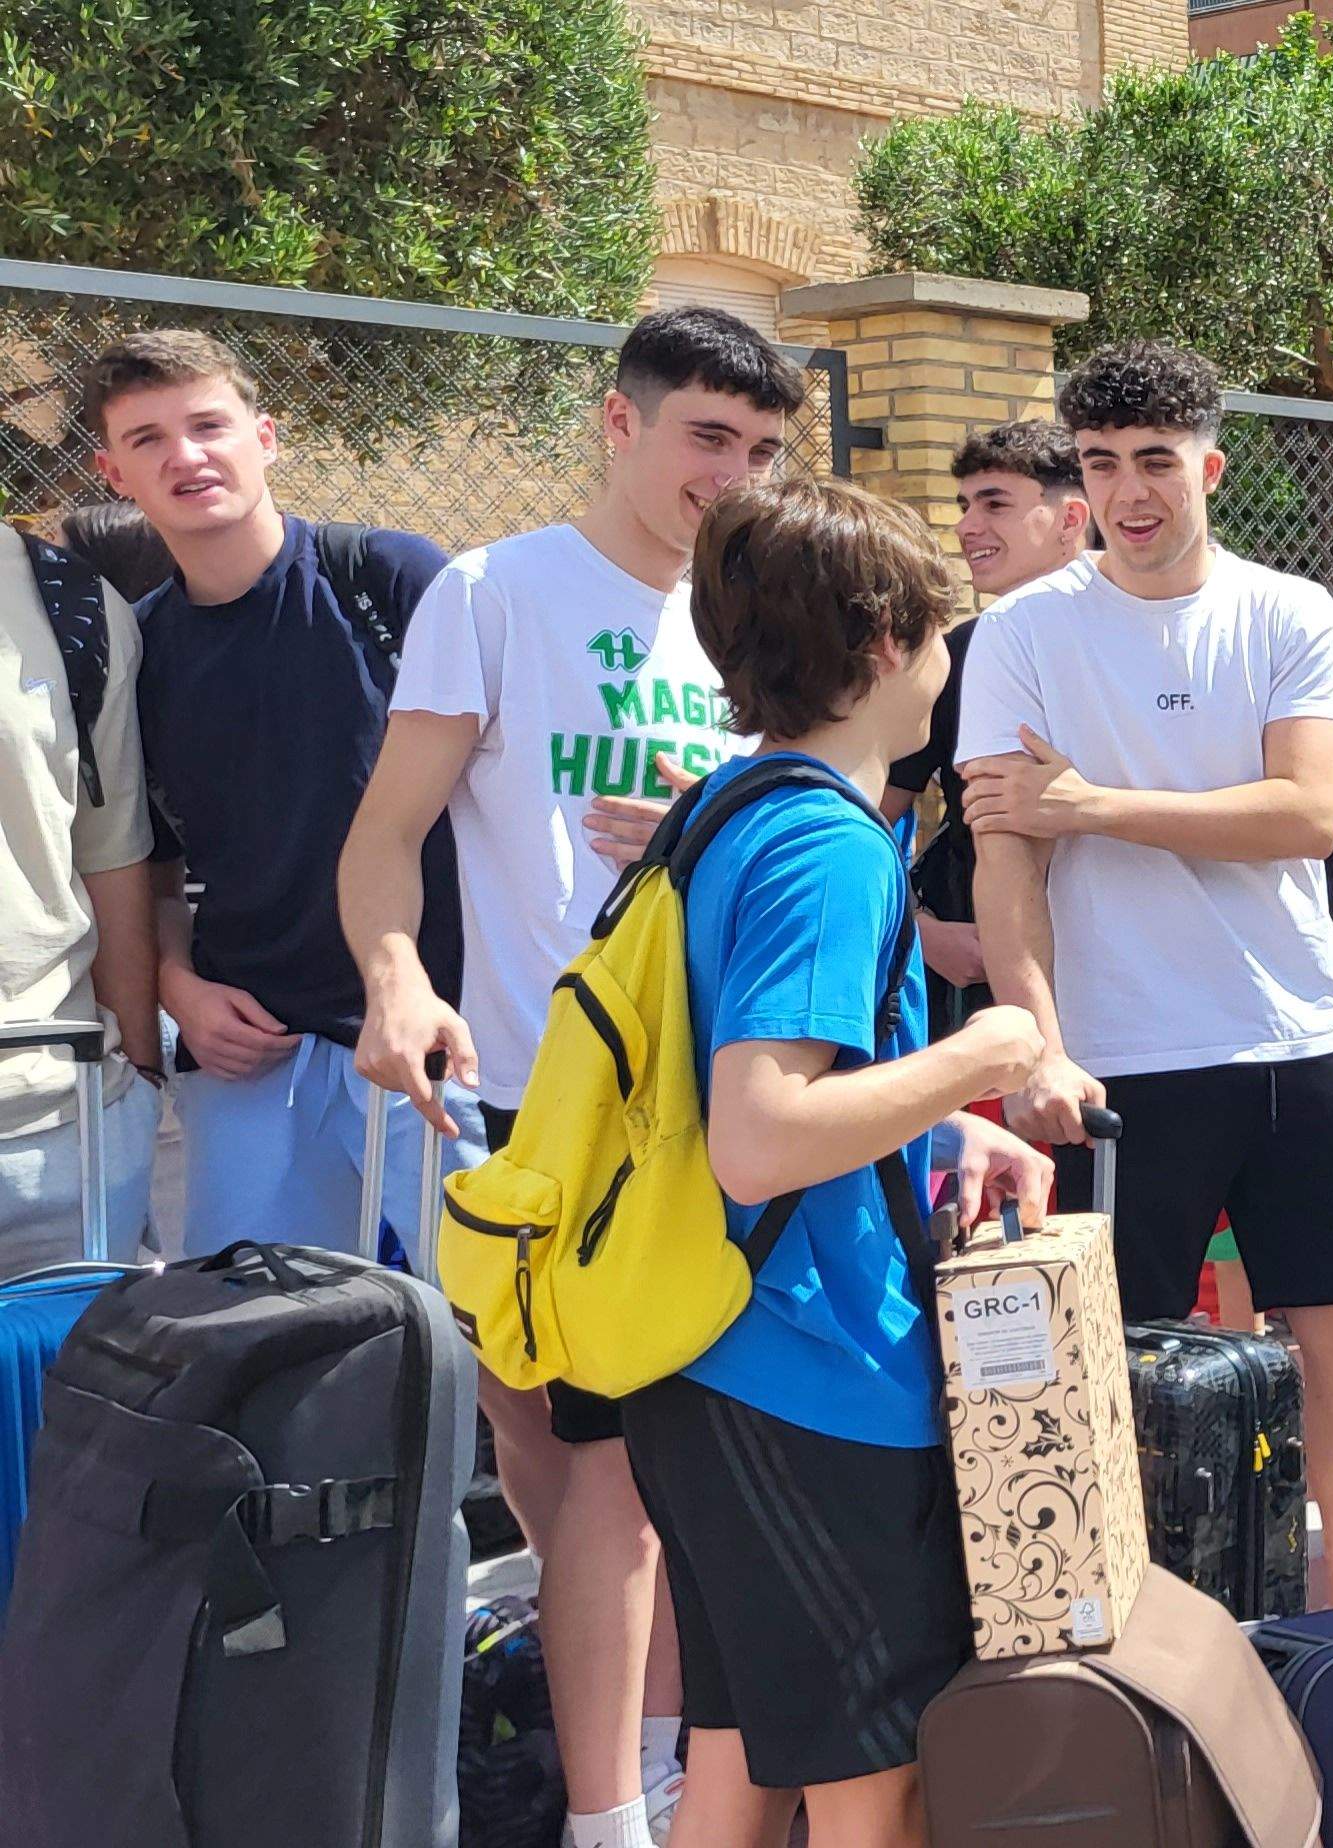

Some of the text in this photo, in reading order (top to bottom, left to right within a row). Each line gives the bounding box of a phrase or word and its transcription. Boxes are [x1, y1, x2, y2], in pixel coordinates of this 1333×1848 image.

[1157, 693, 1194, 710] OFF.
[550, 732, 721, 799] HUES
[964, 1292, 1040, 1319] GRC-1
